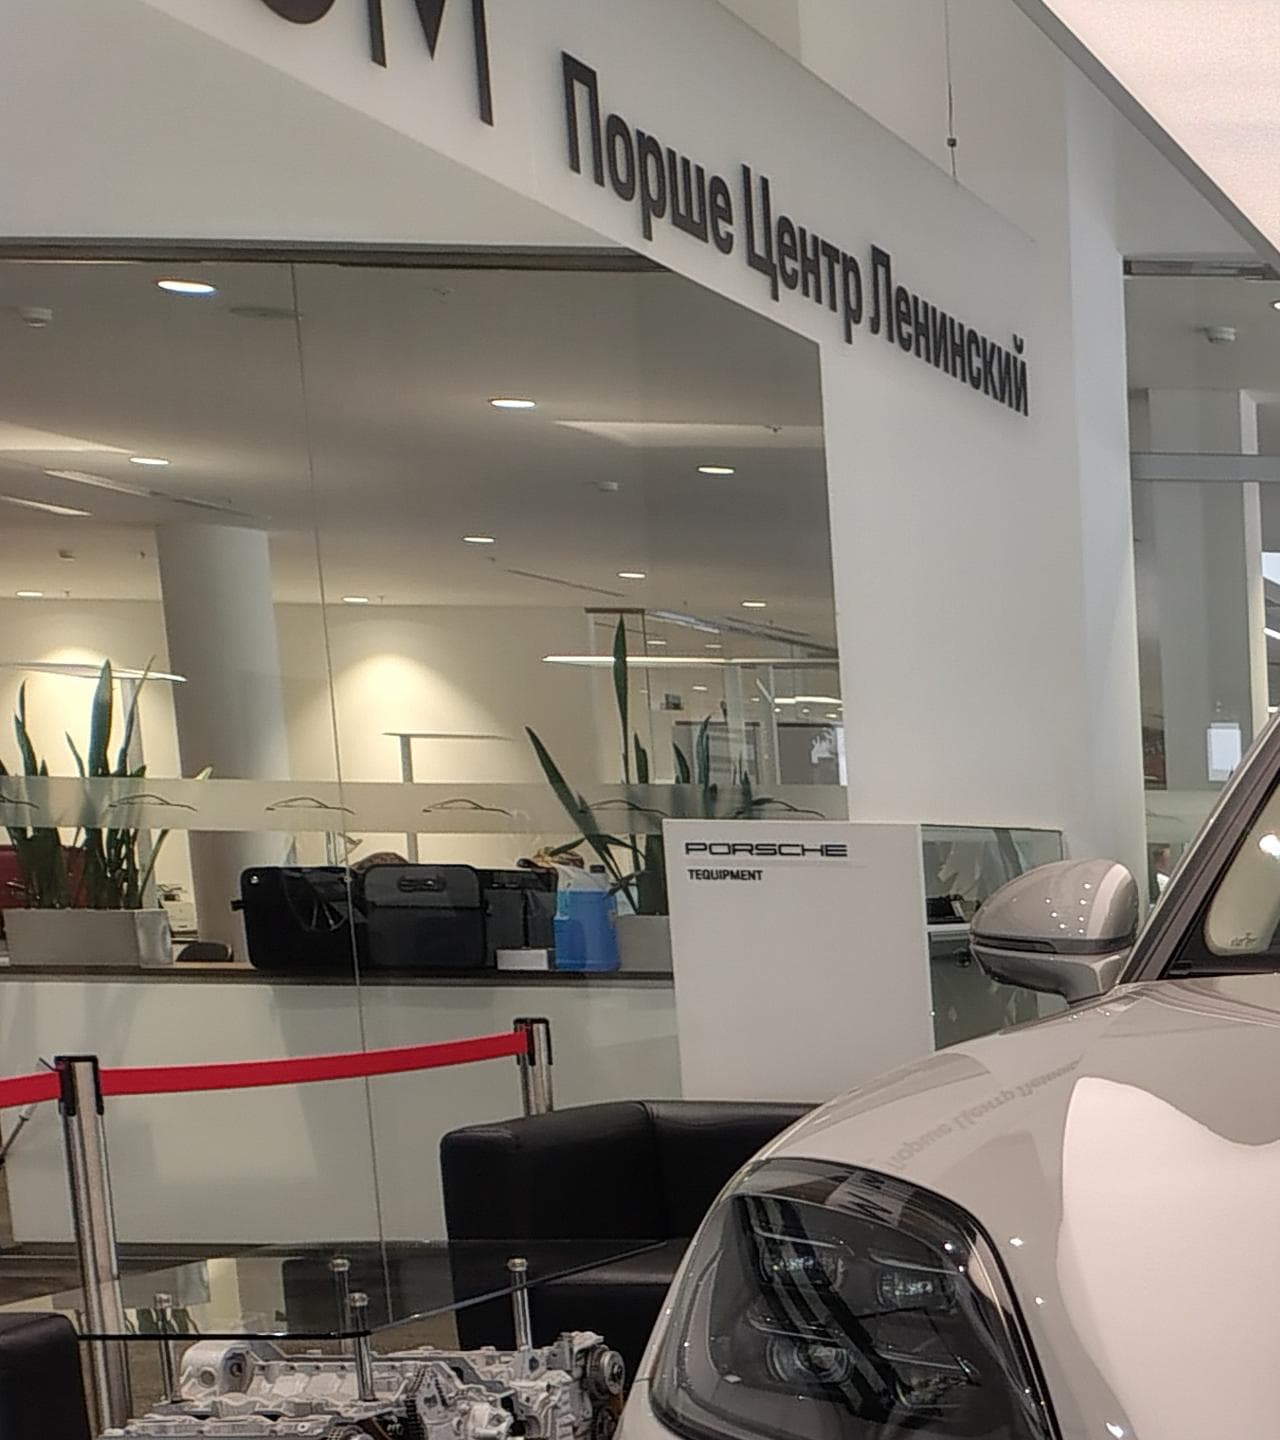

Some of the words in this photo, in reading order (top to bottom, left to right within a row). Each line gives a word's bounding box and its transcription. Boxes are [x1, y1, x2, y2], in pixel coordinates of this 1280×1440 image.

[562, 50, 734, 256] Порше
[741, 163, 864, 346] Центр
[868, 243, 1029, 417] Ленинский
[684, 842, 849, 858] PORSCHE
[687, 868, 764, 882] TEQUIPMENT
